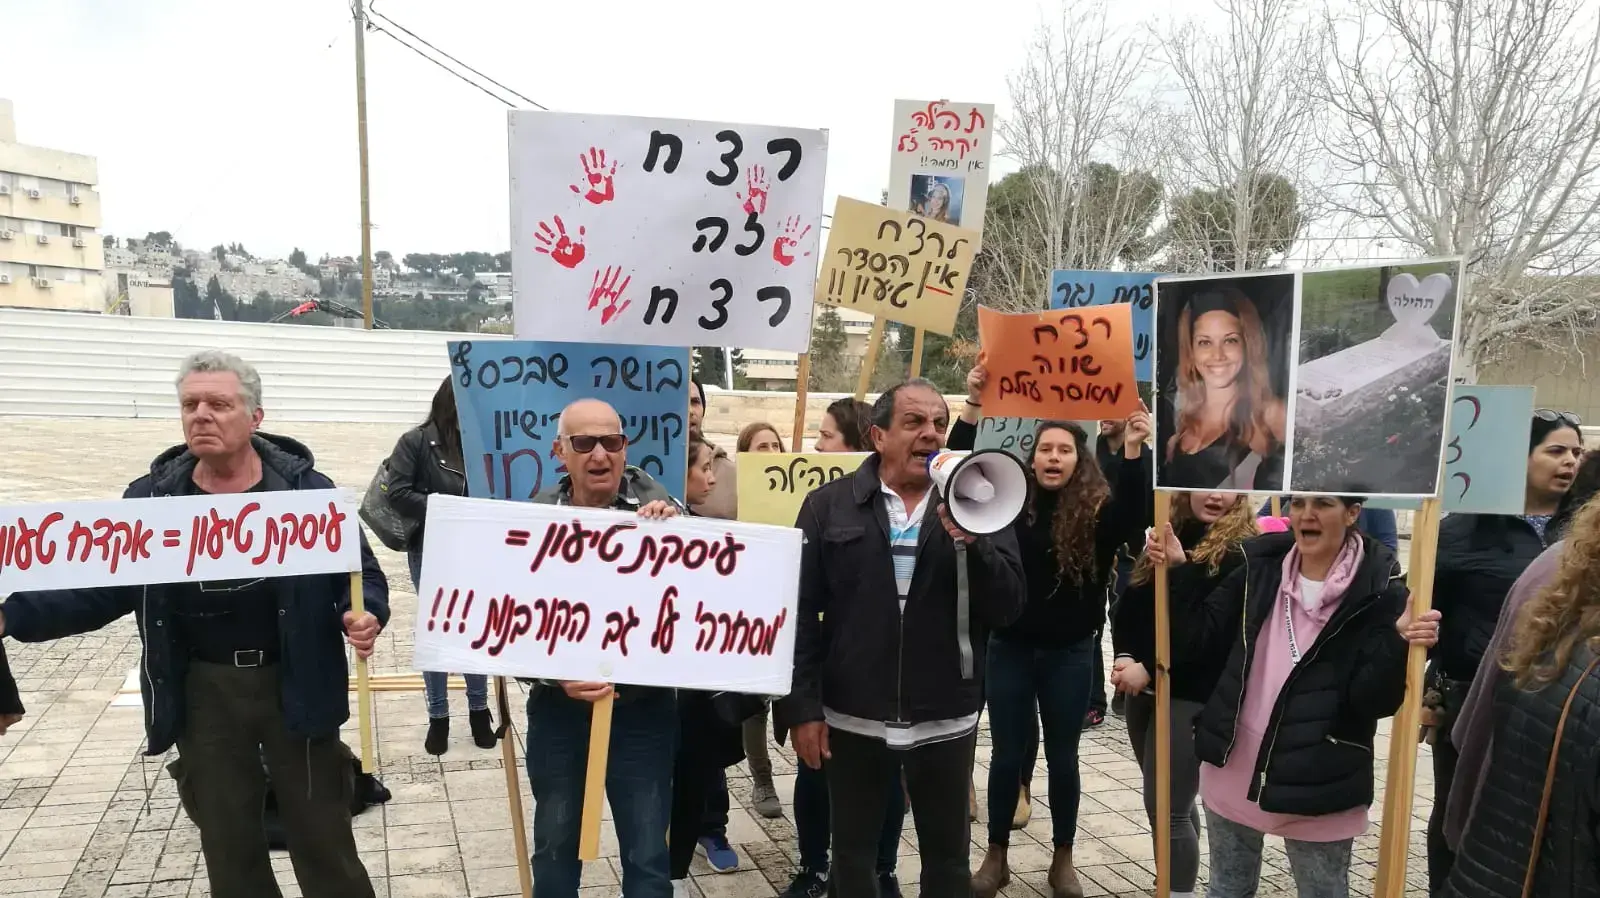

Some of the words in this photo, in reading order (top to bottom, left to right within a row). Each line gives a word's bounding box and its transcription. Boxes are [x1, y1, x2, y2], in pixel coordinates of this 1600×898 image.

[911, 101, 985, 134] תהילה
[642, 129, 802, 187] רצח
[928, 136, 978, 160] יקרה
[967, 160, 985, 173] אין
[692, 211, 766, 256] זה
[877, 218, 969, 259] לרצח
[916, 261, 960, 299] אין
[1393, 293, 1434, 309] תהילה
[642, 277, 792, 330] רצח
[1033, 314, 1112, 349] רצח
[453, 340, 569, 390] שבכסף
[590, 356, 683, 393] בושה
[999, 371, 1042, 402] עולם
[1031, 354, 1102, 376] שווה
[1050, 382, 1123, 404] מאסר
[620, 412, 683, 456] קוני
[67, 519, 153, 574] אקדח
[185, 502, 261, 576] טיעון
[251, 501, 347, 565] עיסקת
[530, 519, 638, 573] טיעון
[617, 533, 746, 577] עיסקת
[470, 593, 591, 657] הקורבנות
[600, 605, 641, 656] גב
[650, 585, 680, 654] על
